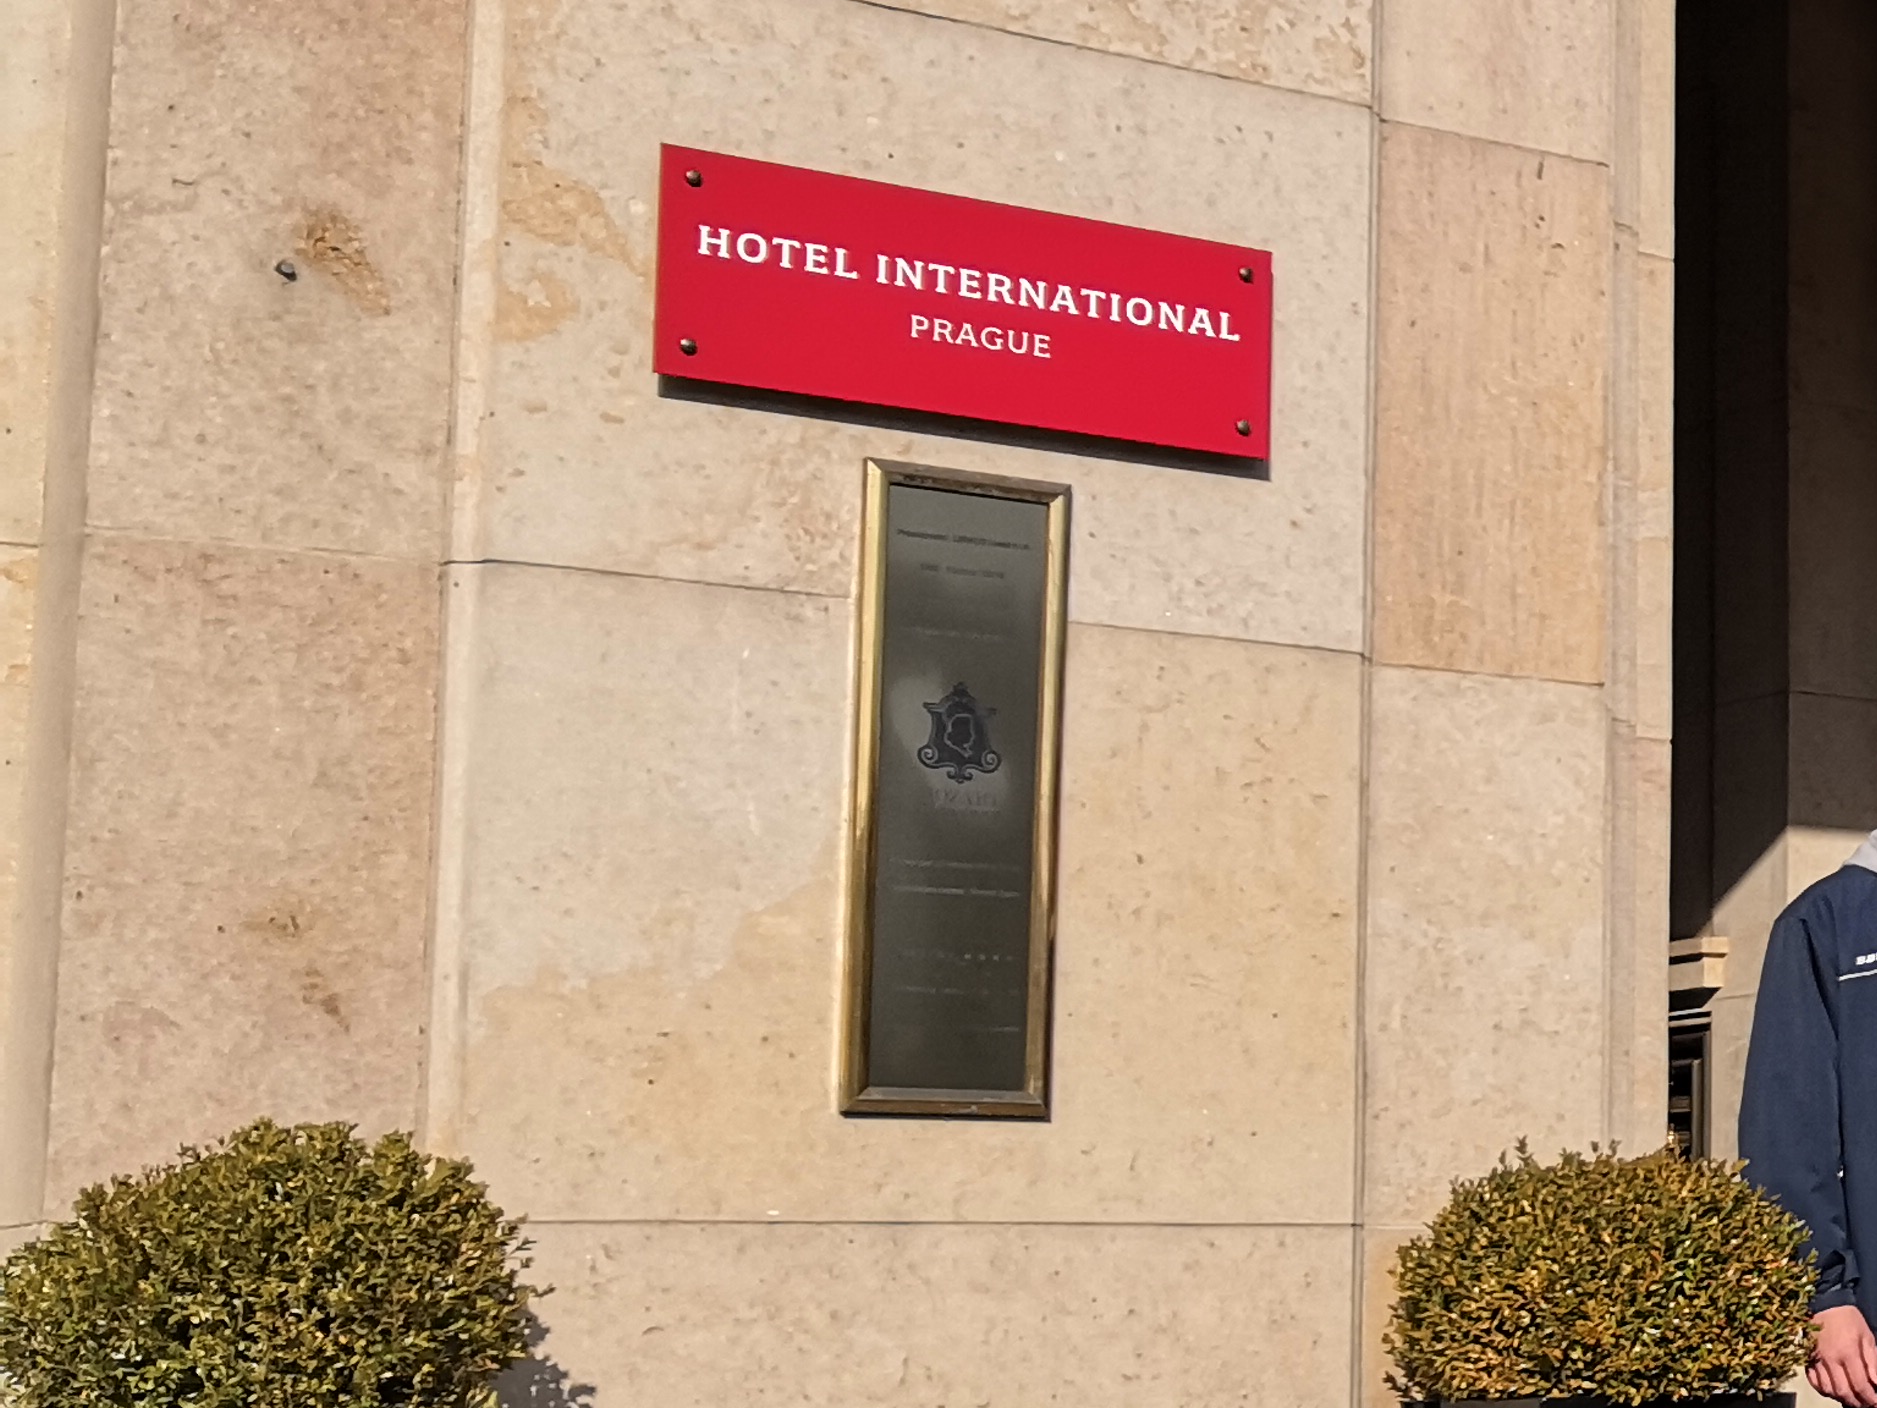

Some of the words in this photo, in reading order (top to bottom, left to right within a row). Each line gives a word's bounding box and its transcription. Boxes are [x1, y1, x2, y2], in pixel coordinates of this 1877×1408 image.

[697, 224, 859, 280] HOTEL
[875, 253, 1241, 342] INTERNATIONAL
[910, 314, 1051, 359] PRAGUE
